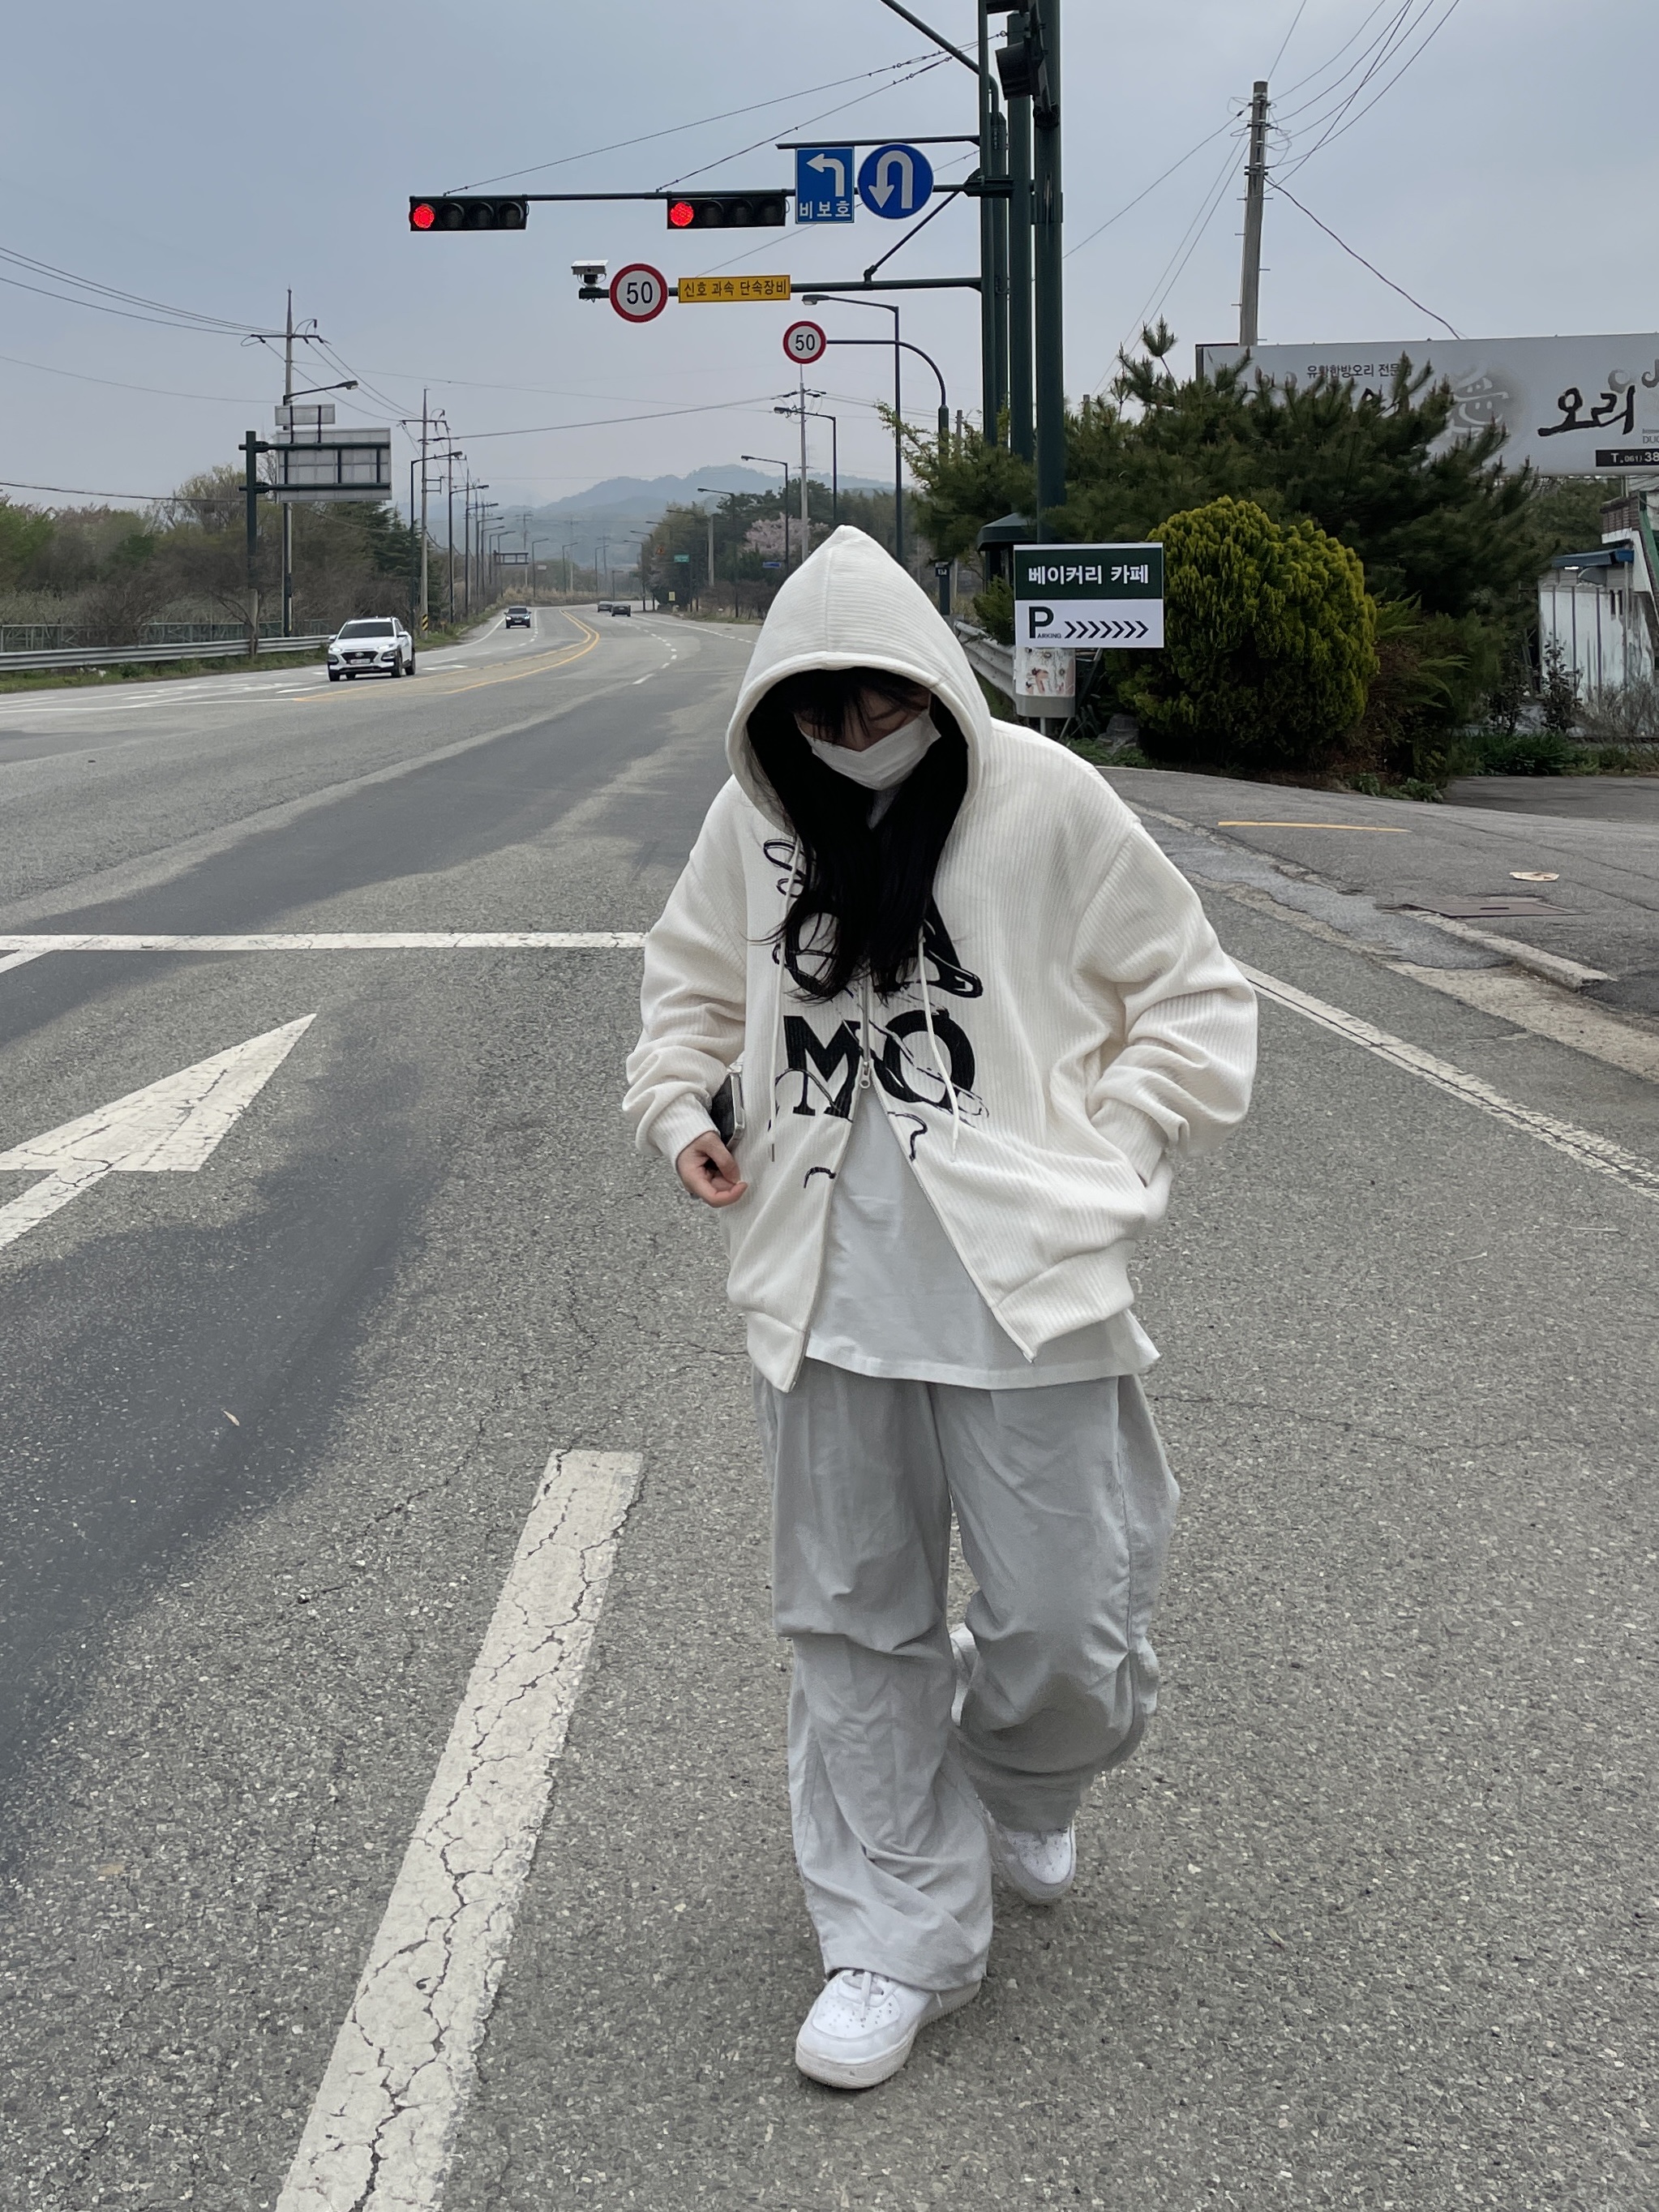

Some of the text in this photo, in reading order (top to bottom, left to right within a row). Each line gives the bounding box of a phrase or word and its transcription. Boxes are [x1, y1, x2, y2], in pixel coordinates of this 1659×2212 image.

[799, 200, 851, 219] 비보호
[627, 281, 653, 304] 50
[684, 279, 786, 297] 신호 과속 단속장비
[795, 334, 815, 351] 50
[1378, 363, 1412, 377] 전문
[1537, 385, 1635, 436] 오리
[1028, 564, 1149, 585] 베이커리 카페
